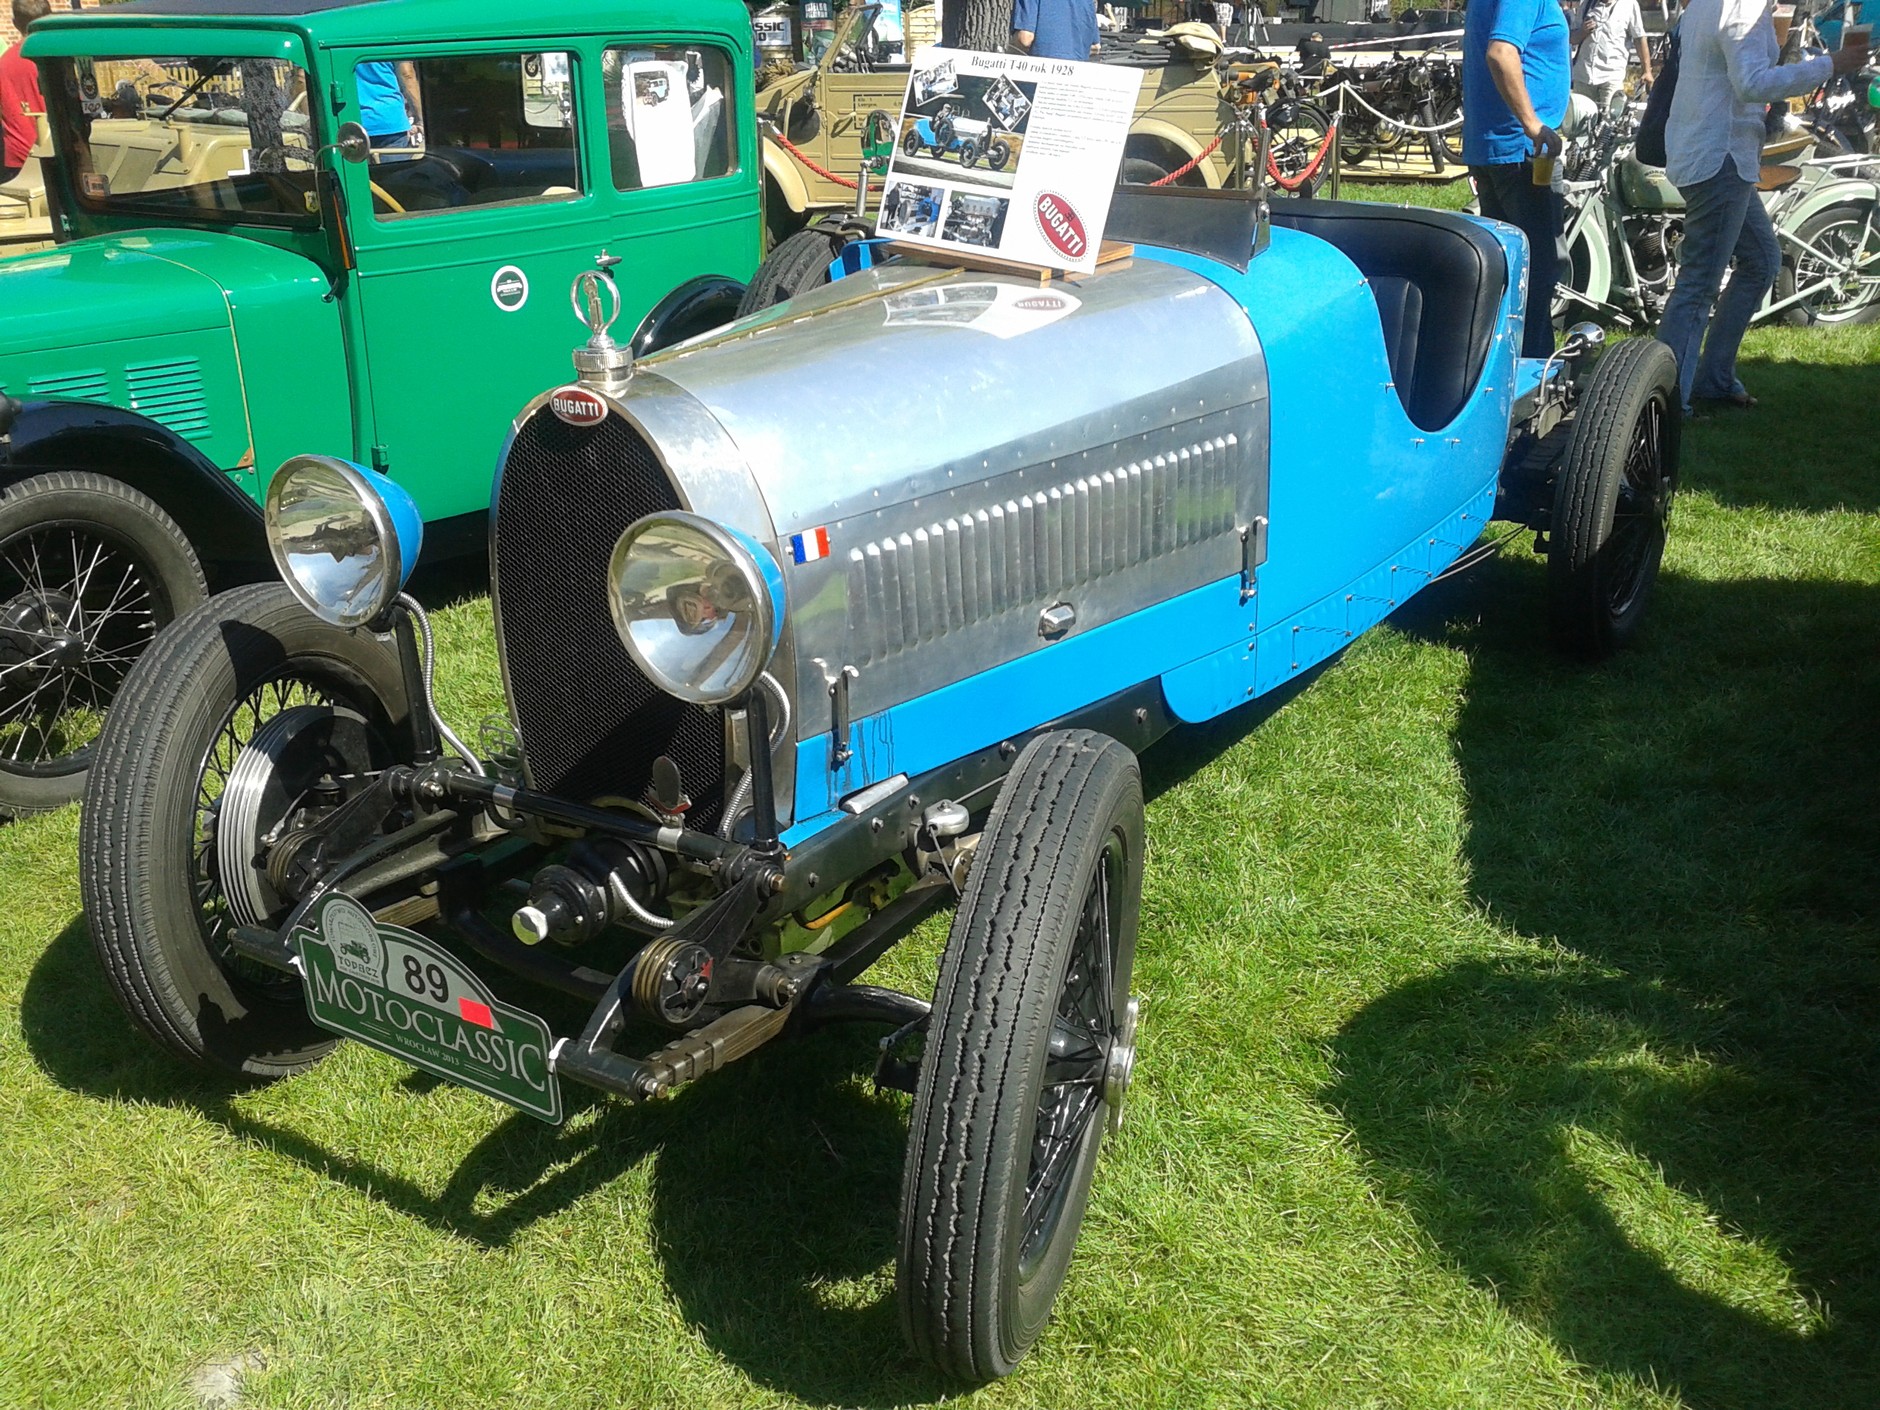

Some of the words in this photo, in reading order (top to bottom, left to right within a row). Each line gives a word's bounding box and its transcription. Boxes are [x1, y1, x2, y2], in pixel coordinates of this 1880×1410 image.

[971, 55, 1007, 70] Bugatti
[1009, 59, 1028, 71] T40
[1030, 62, 1047, 74] rok
[1051, 64, 1075, 76] 1928
[1039, 196, 1084, 255] BUGATTI
[553, 397, 599, 417] BUGATTI
[402, 954, 449, 1003] 89
[313, 960, 546, 1092] MOTOCLASSIC
[442, 1053, 460, 1066] 2013
